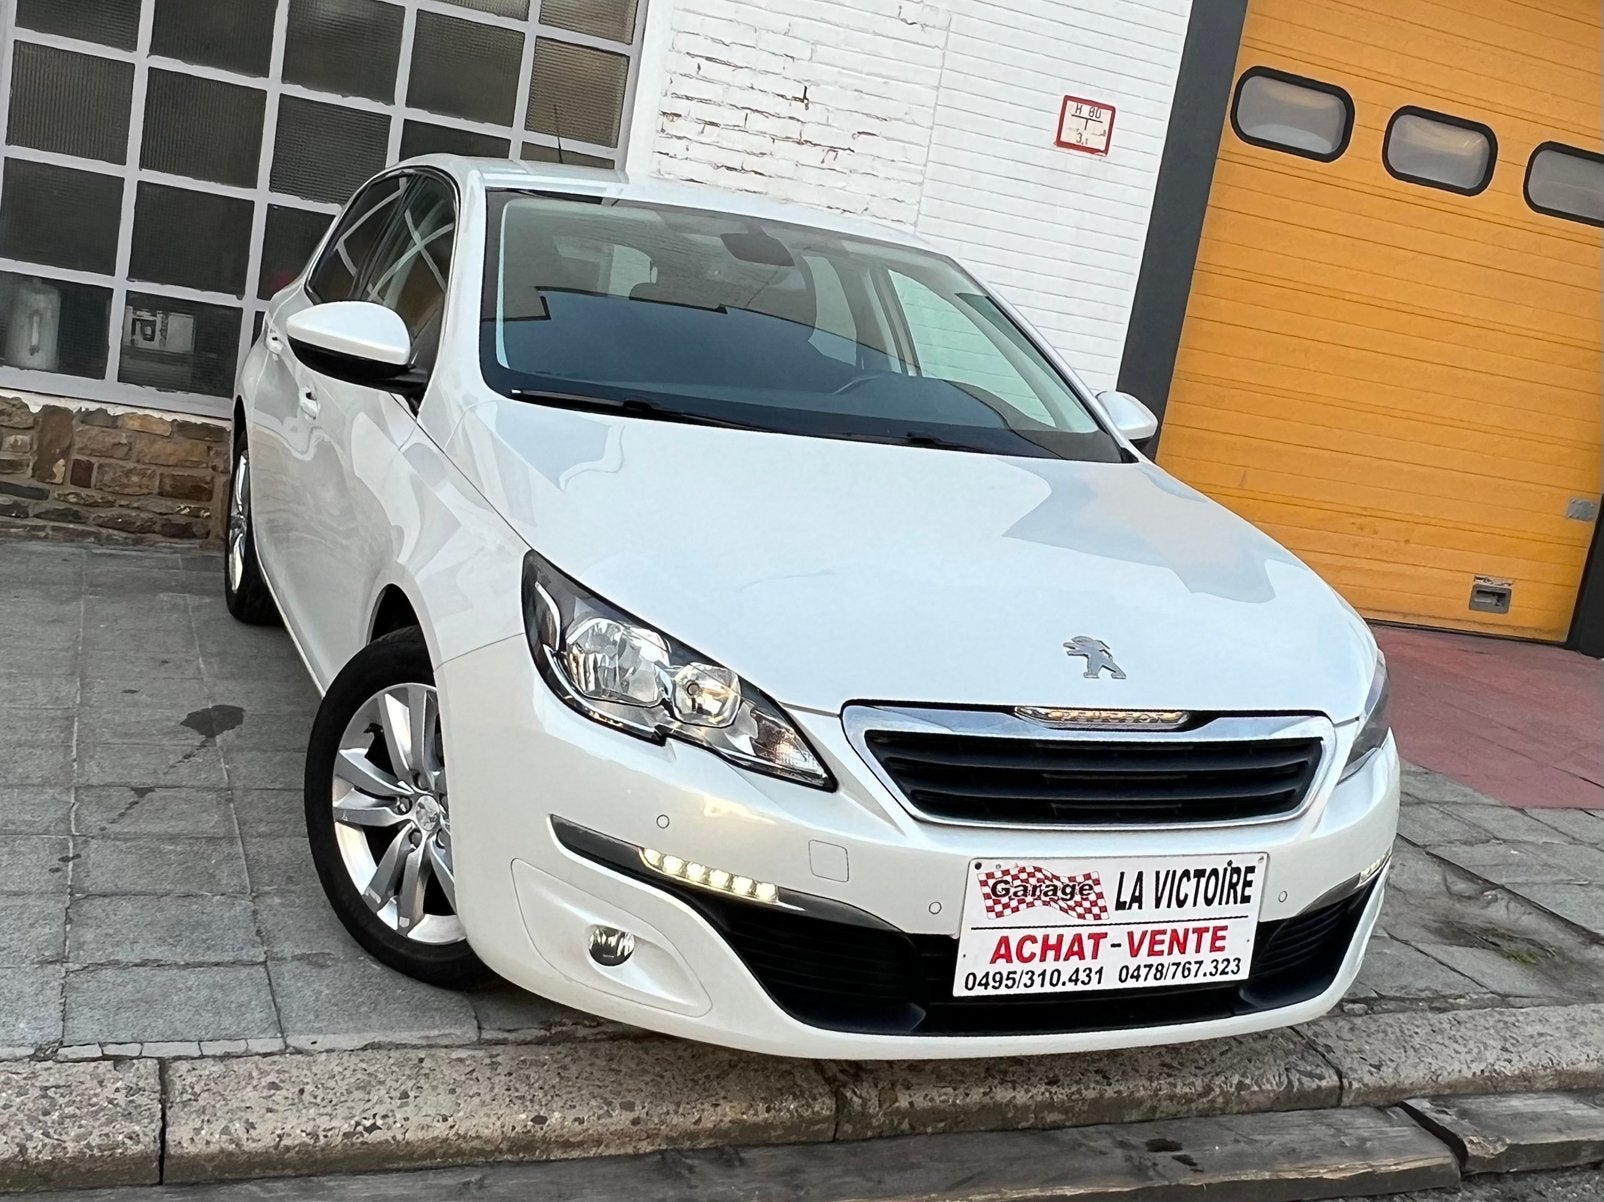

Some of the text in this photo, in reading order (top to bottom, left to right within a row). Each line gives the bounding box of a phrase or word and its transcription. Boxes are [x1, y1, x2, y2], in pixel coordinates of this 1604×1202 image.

[1075, 103, 1083, 115] H
[990, 865, 1256, 911] Garage LA VICTOIRE
[964, 957, 1242, 992] 0495/310.431 0478/767.323
